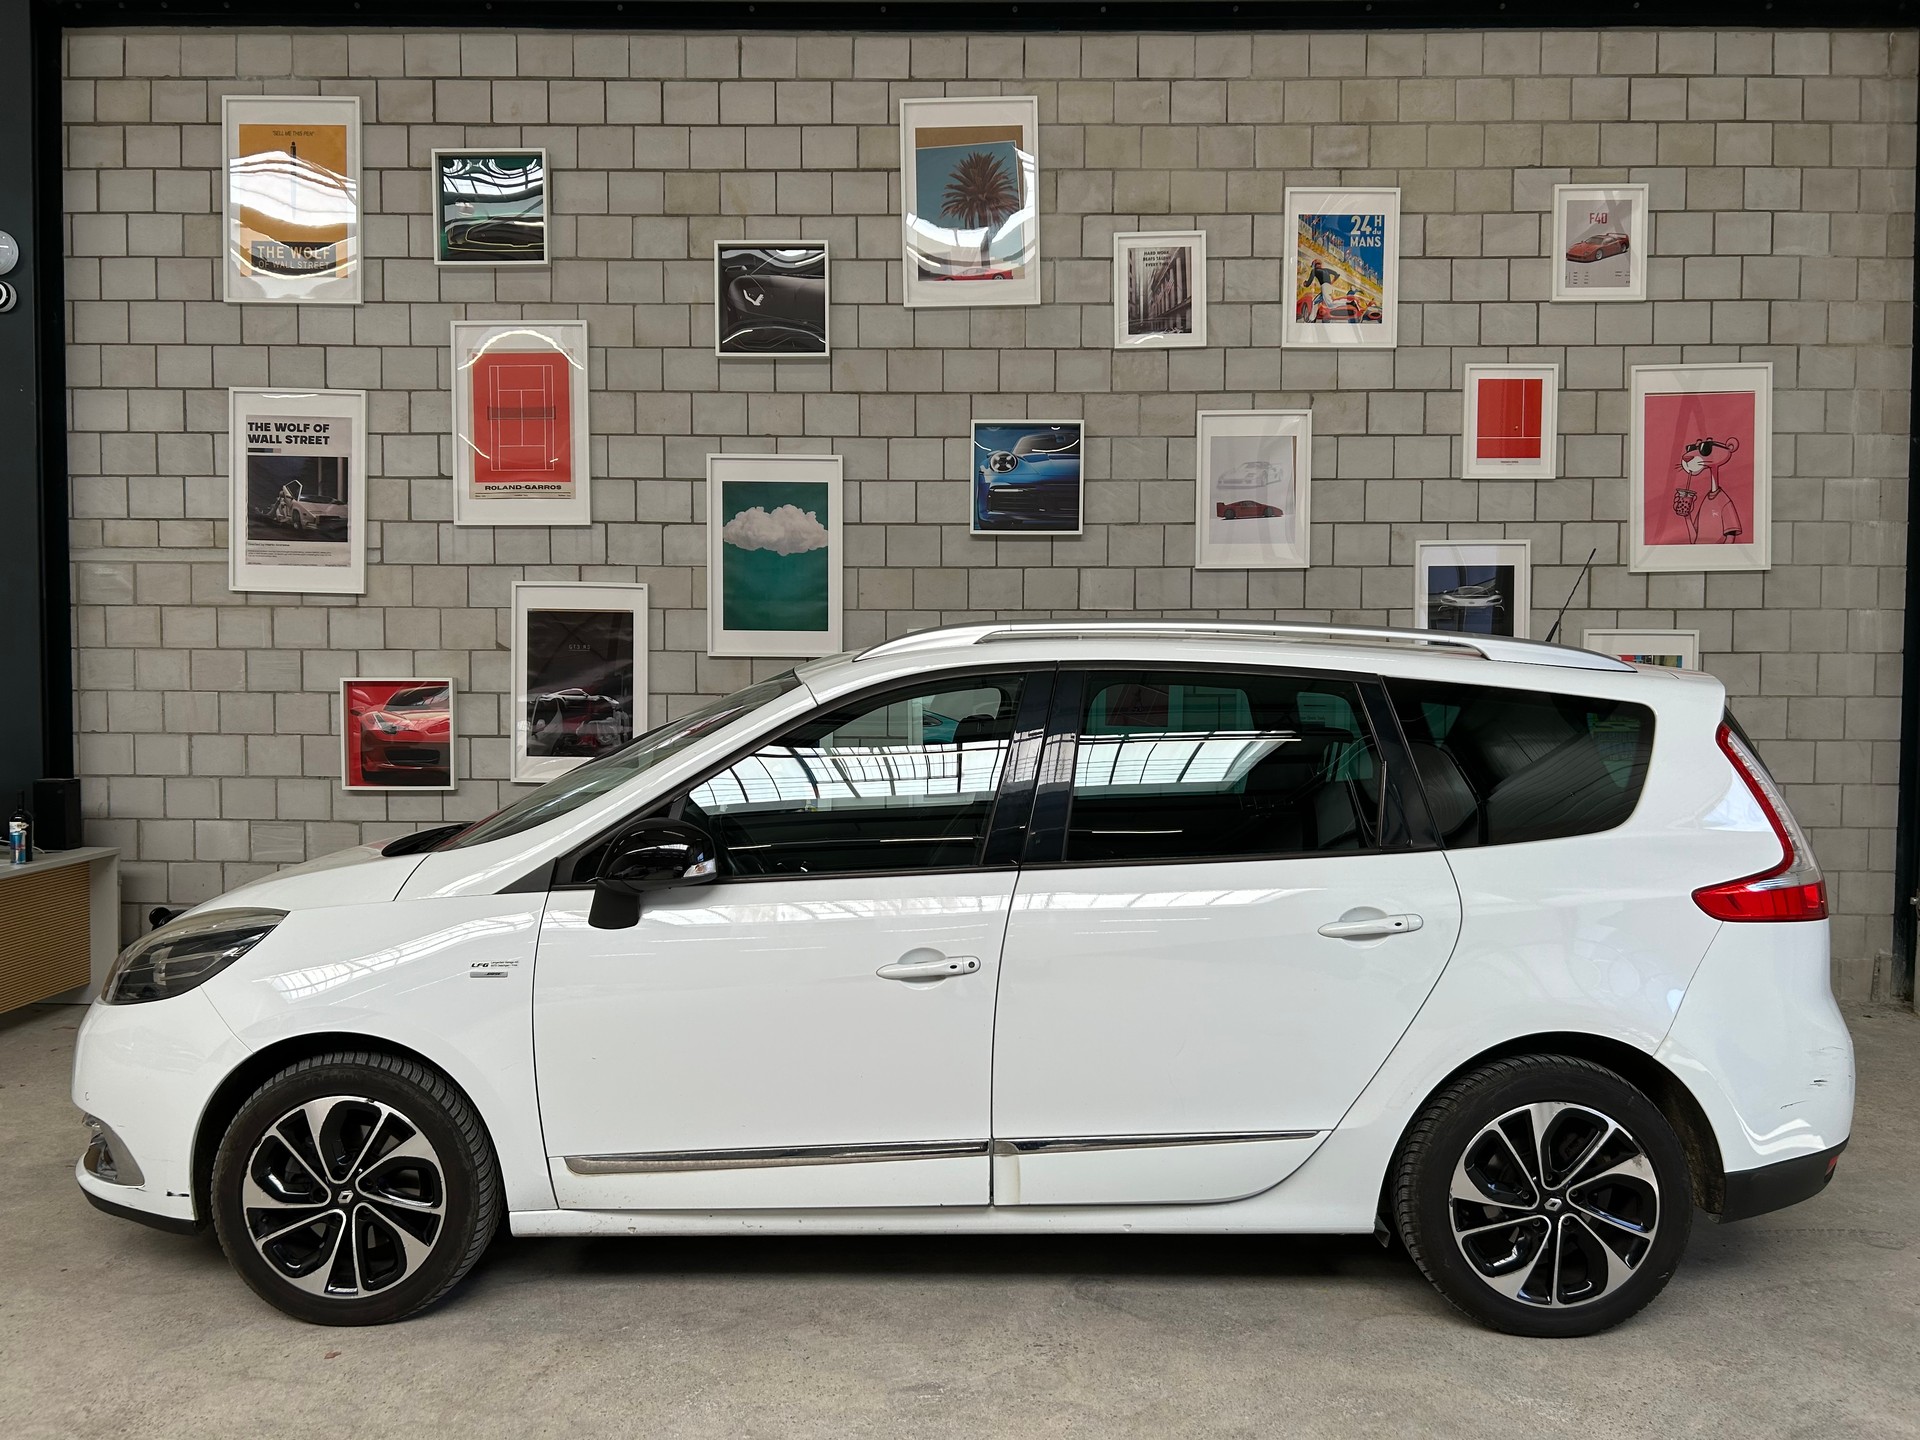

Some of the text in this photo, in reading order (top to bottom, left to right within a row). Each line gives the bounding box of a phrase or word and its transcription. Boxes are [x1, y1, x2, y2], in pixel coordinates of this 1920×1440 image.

[1589, 212, 1608, 225] F40
[1350, 215, 1382, 235] 24 H
[1372, 227, 1382, 235] du
[1350, 236, 1382, 247] MANS
[257, 245, 330, 260] THE WOLF
[258, 260, 330, 270] OF WALL STREET
[247, 422, 330, 433] THE WOLF OF
[247, 434, 330, 445] WALL STREET
